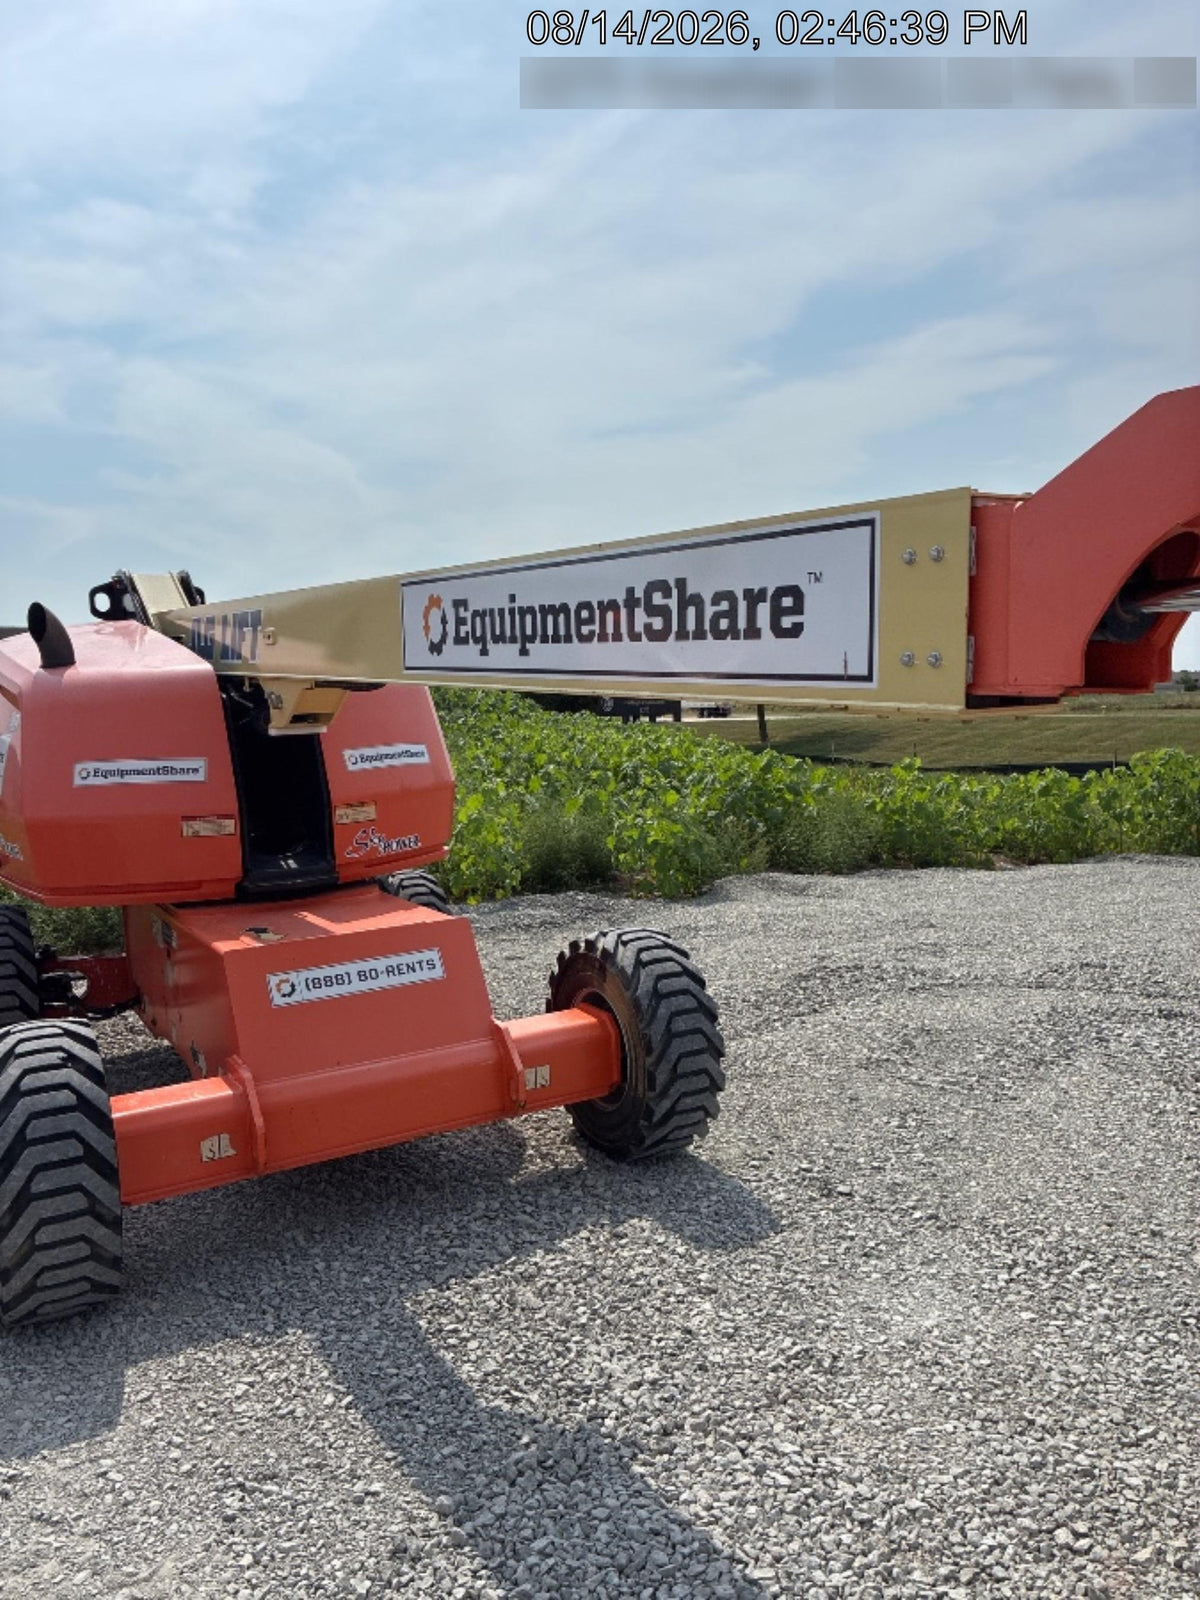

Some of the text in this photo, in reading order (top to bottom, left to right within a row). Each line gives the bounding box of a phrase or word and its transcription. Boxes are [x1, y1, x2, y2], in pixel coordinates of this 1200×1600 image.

[452, 577, 804, 656] EquipmentShare
[92, 766, 200, 779] EquipmentShare
[304, 971, 352, 992] (888)
